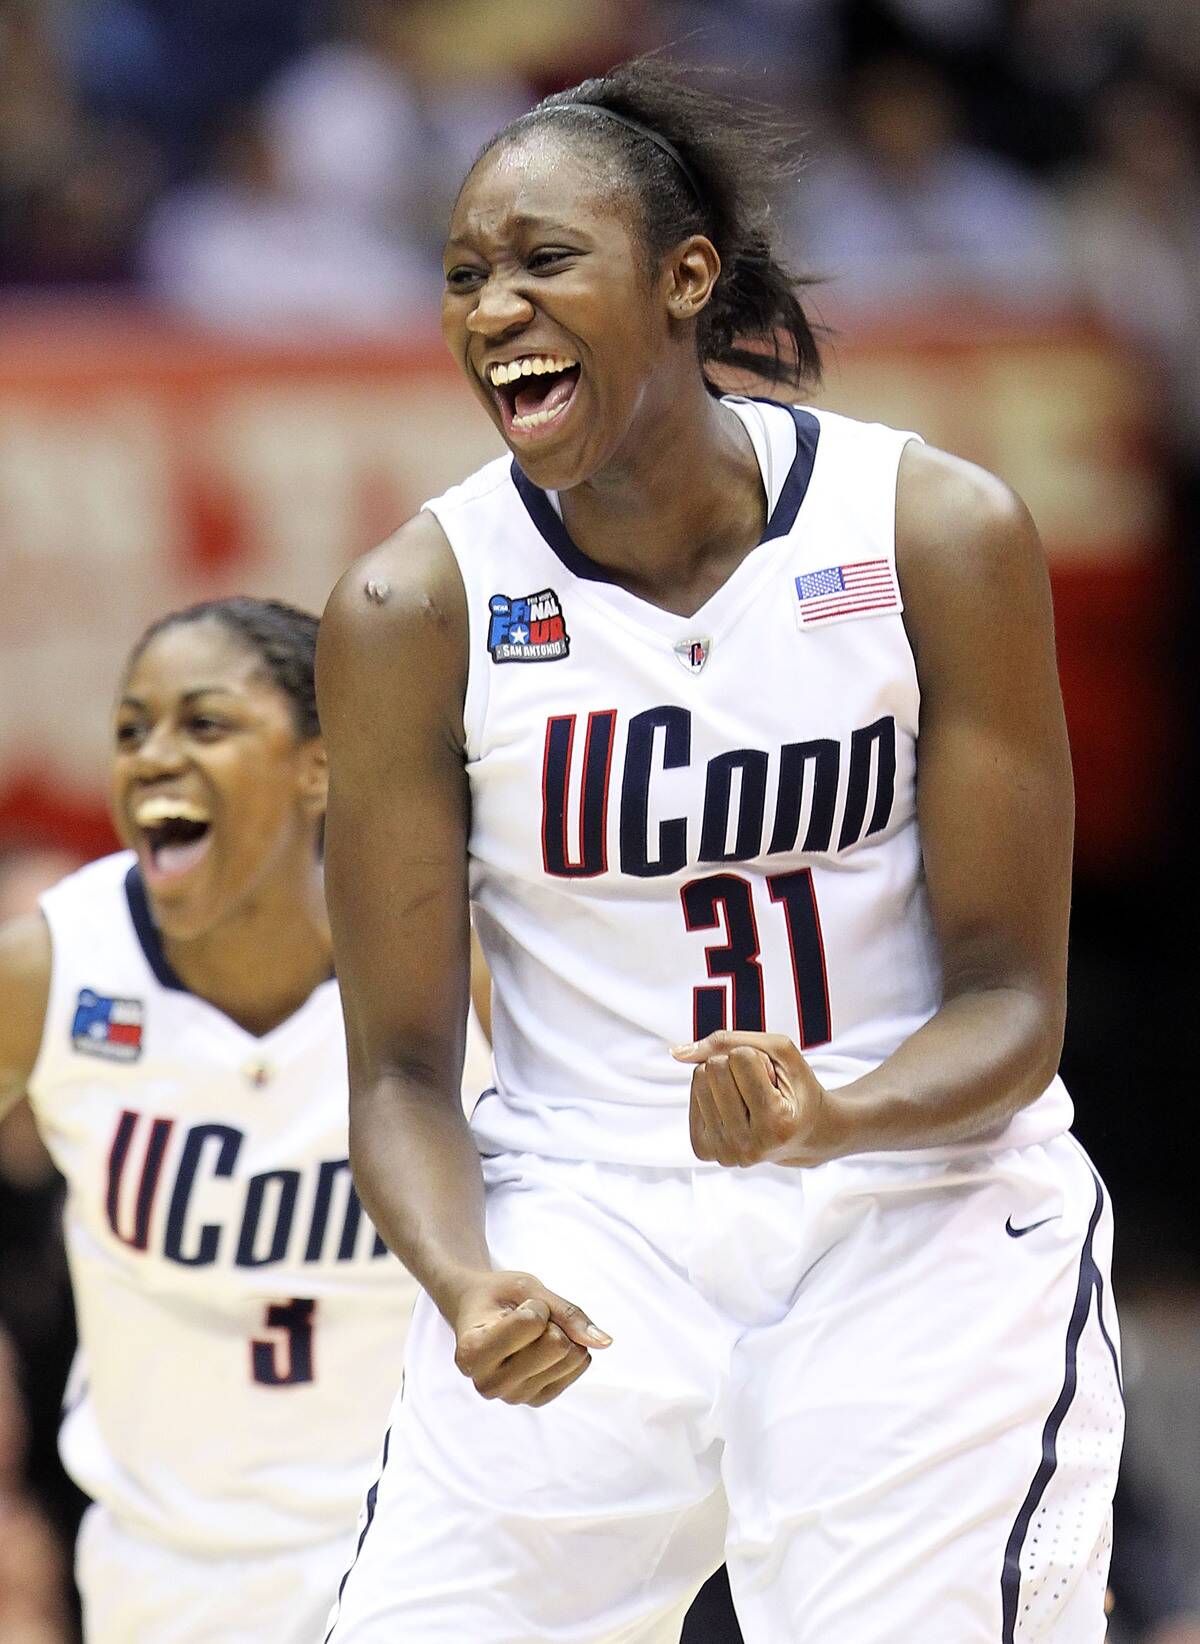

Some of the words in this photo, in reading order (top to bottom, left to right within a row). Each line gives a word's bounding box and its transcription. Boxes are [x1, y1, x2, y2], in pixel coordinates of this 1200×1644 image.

[503, 644, 522, 657] SAN
[524, 641, 561, 657] ANTONIO
[511, 597, 560, 622] FINAL
[542, 705, 896, 878] UConn
[680, 867, 832, 1050] 31
[105, 1110, 389, 1269] UCon
[251, 1298, 317, 1388] 3
